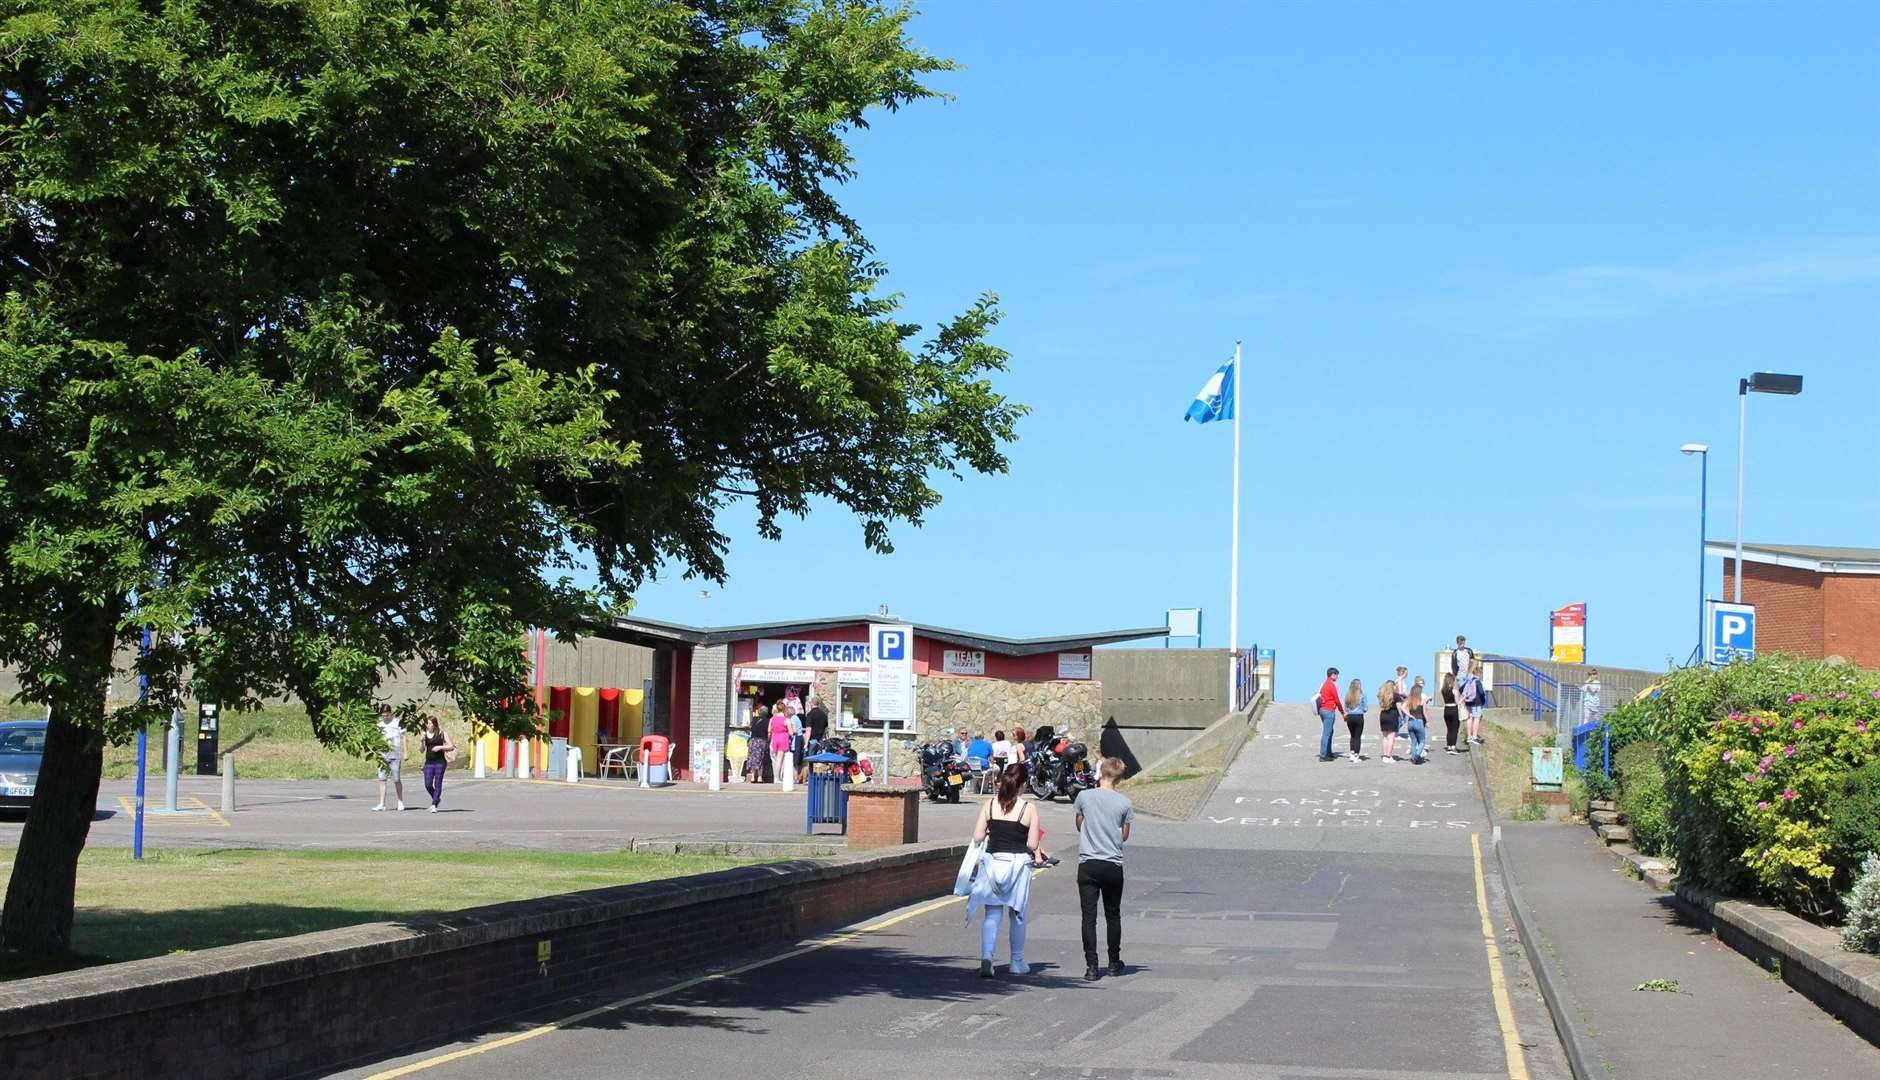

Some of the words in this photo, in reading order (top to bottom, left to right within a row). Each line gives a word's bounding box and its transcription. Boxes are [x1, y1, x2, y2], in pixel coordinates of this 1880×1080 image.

[1722, 615, 1746, 644] P
[783, 643, 806, 660] ICE
[885, 633, 899, 657] P
[955, 651, 973, 662] TEA
[1319, 788, 1380, 798] NO
[1312, 808, 1371, 817] NO
